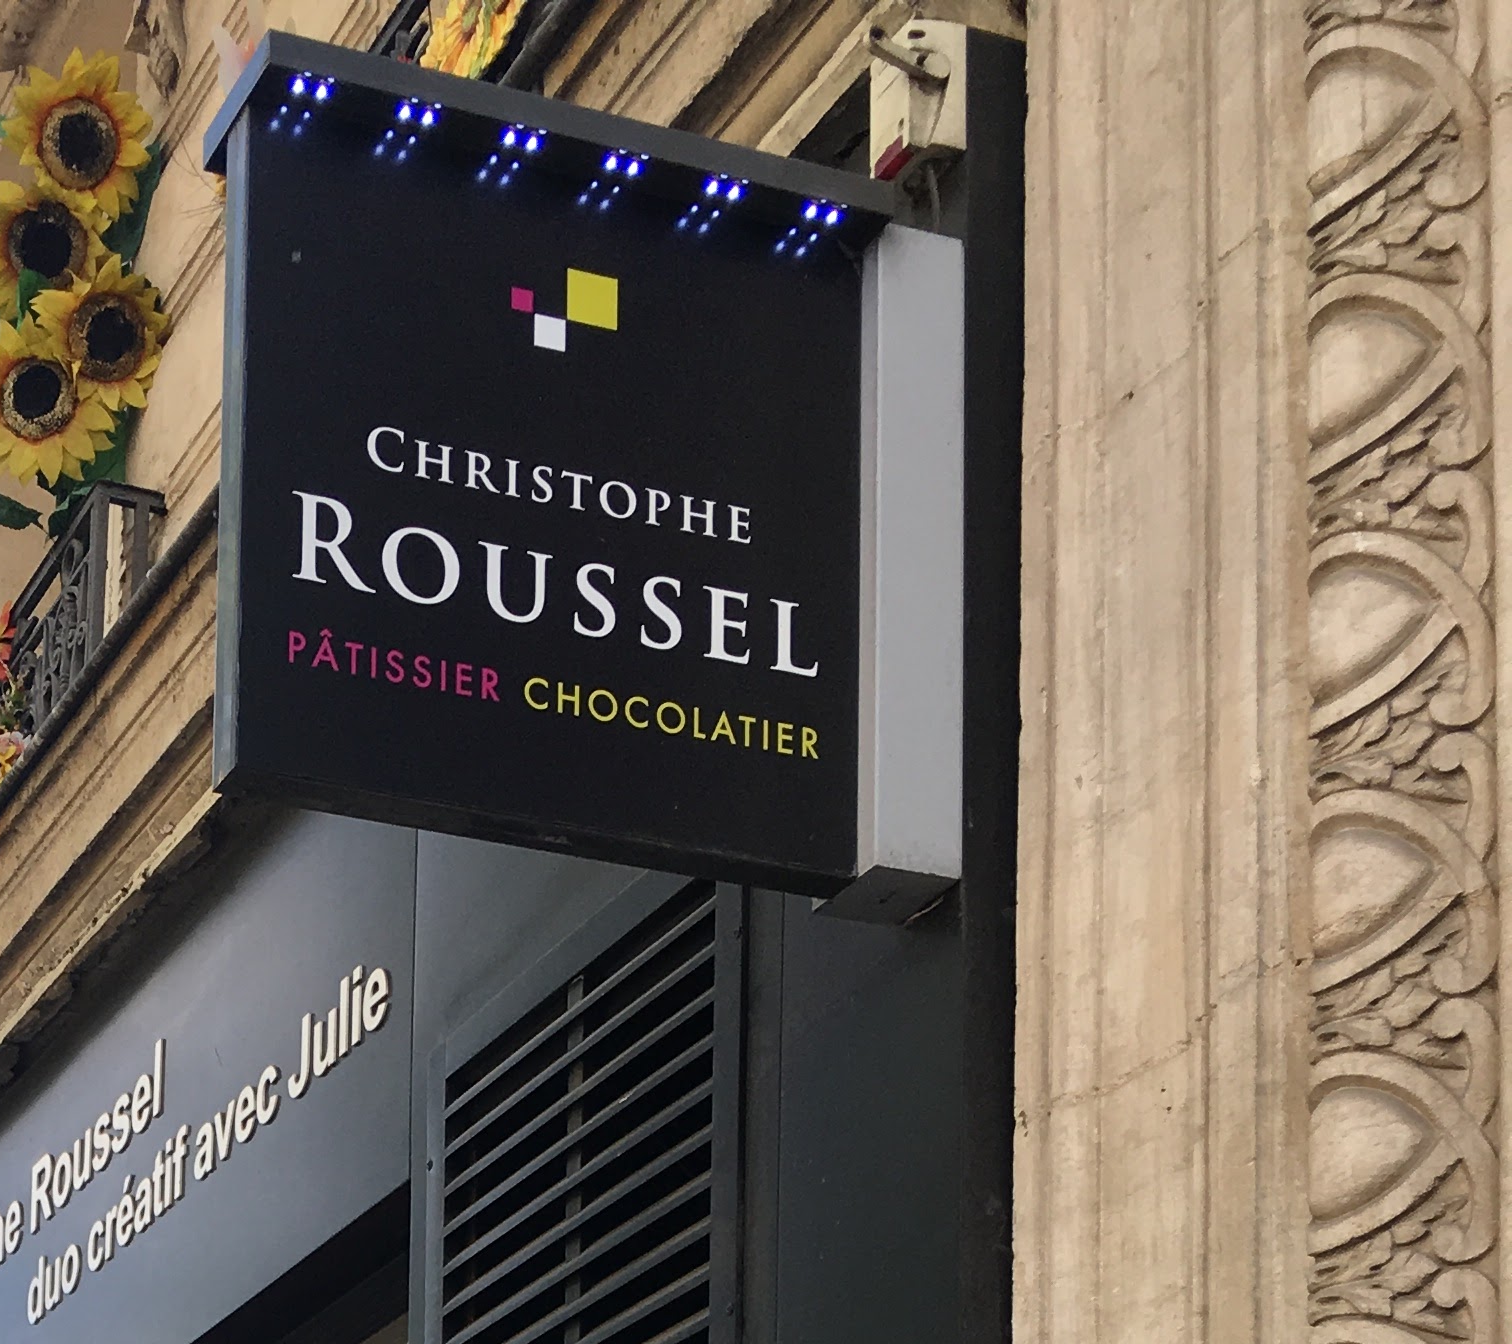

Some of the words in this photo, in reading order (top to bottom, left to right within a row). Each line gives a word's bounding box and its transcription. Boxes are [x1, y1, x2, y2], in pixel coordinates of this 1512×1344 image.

[366, 425, 753, 545] CHRISTOPHE
[291, 489, 820, 679] ROUSSEL
[288, 628, 500, 702] PÂTISSIER
[523, 677, 820, 760] CHOCOLATIER
[27, 1244, 83, 1326] duo
[87, 1123, 191, 1273] créatif
[193, 1064, 281, 1182] avec
[288, 965, 391, 1100] Julie
[29, 1038, 168, 1235] Roussel
